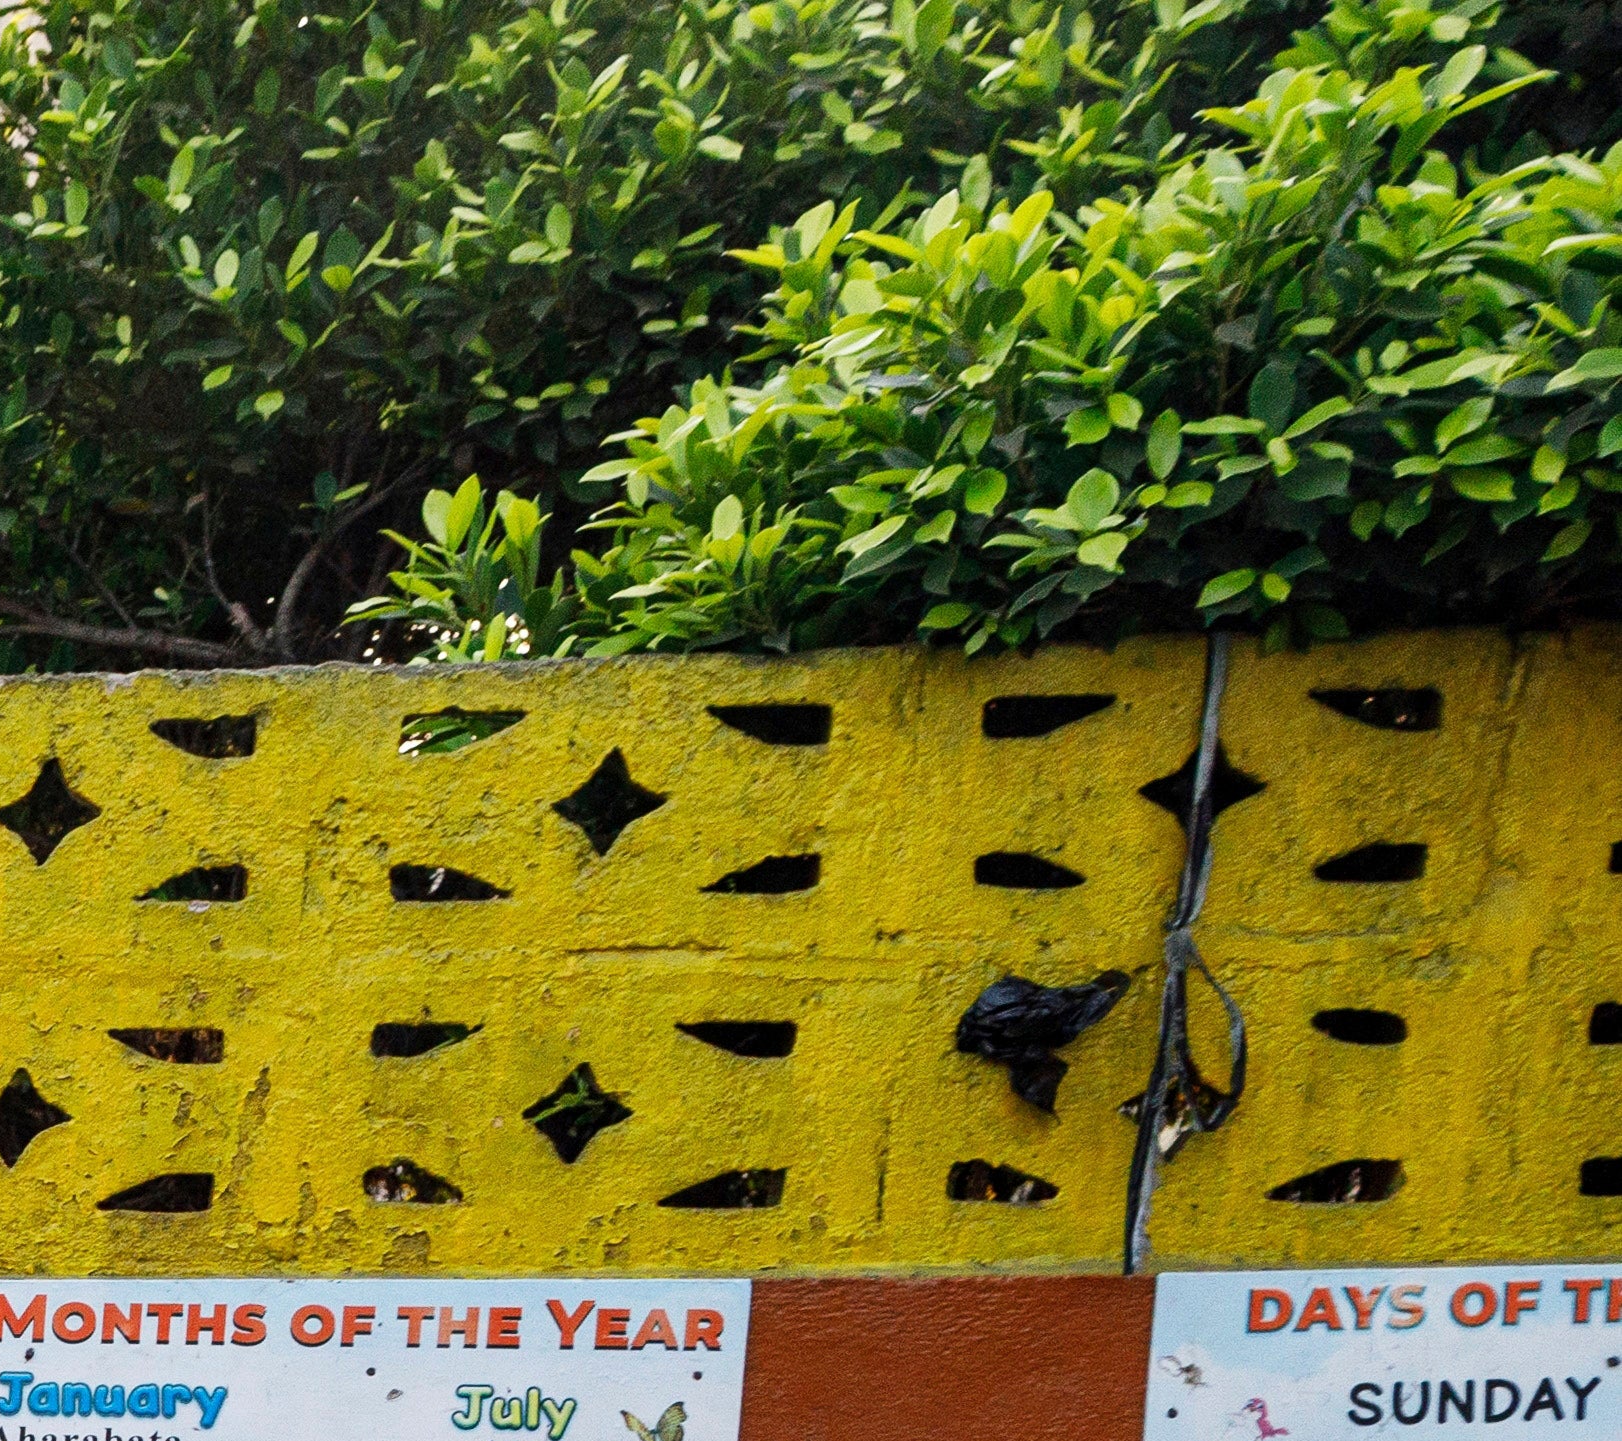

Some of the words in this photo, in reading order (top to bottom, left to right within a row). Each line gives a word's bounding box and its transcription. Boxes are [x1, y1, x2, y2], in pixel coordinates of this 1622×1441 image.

[289, 1304, 377, 1348] OF
[398, 1305, 522, 1350] THE
[545, 1299, 726, 1351] YEAR
[1247, 1284, 1426, 1334] DAYS
[1451, 1281, 1544, 1328] OF
[451, 1384, 578, 1441] July
[1347, 1376, 1602, 1427] SUNDAY
